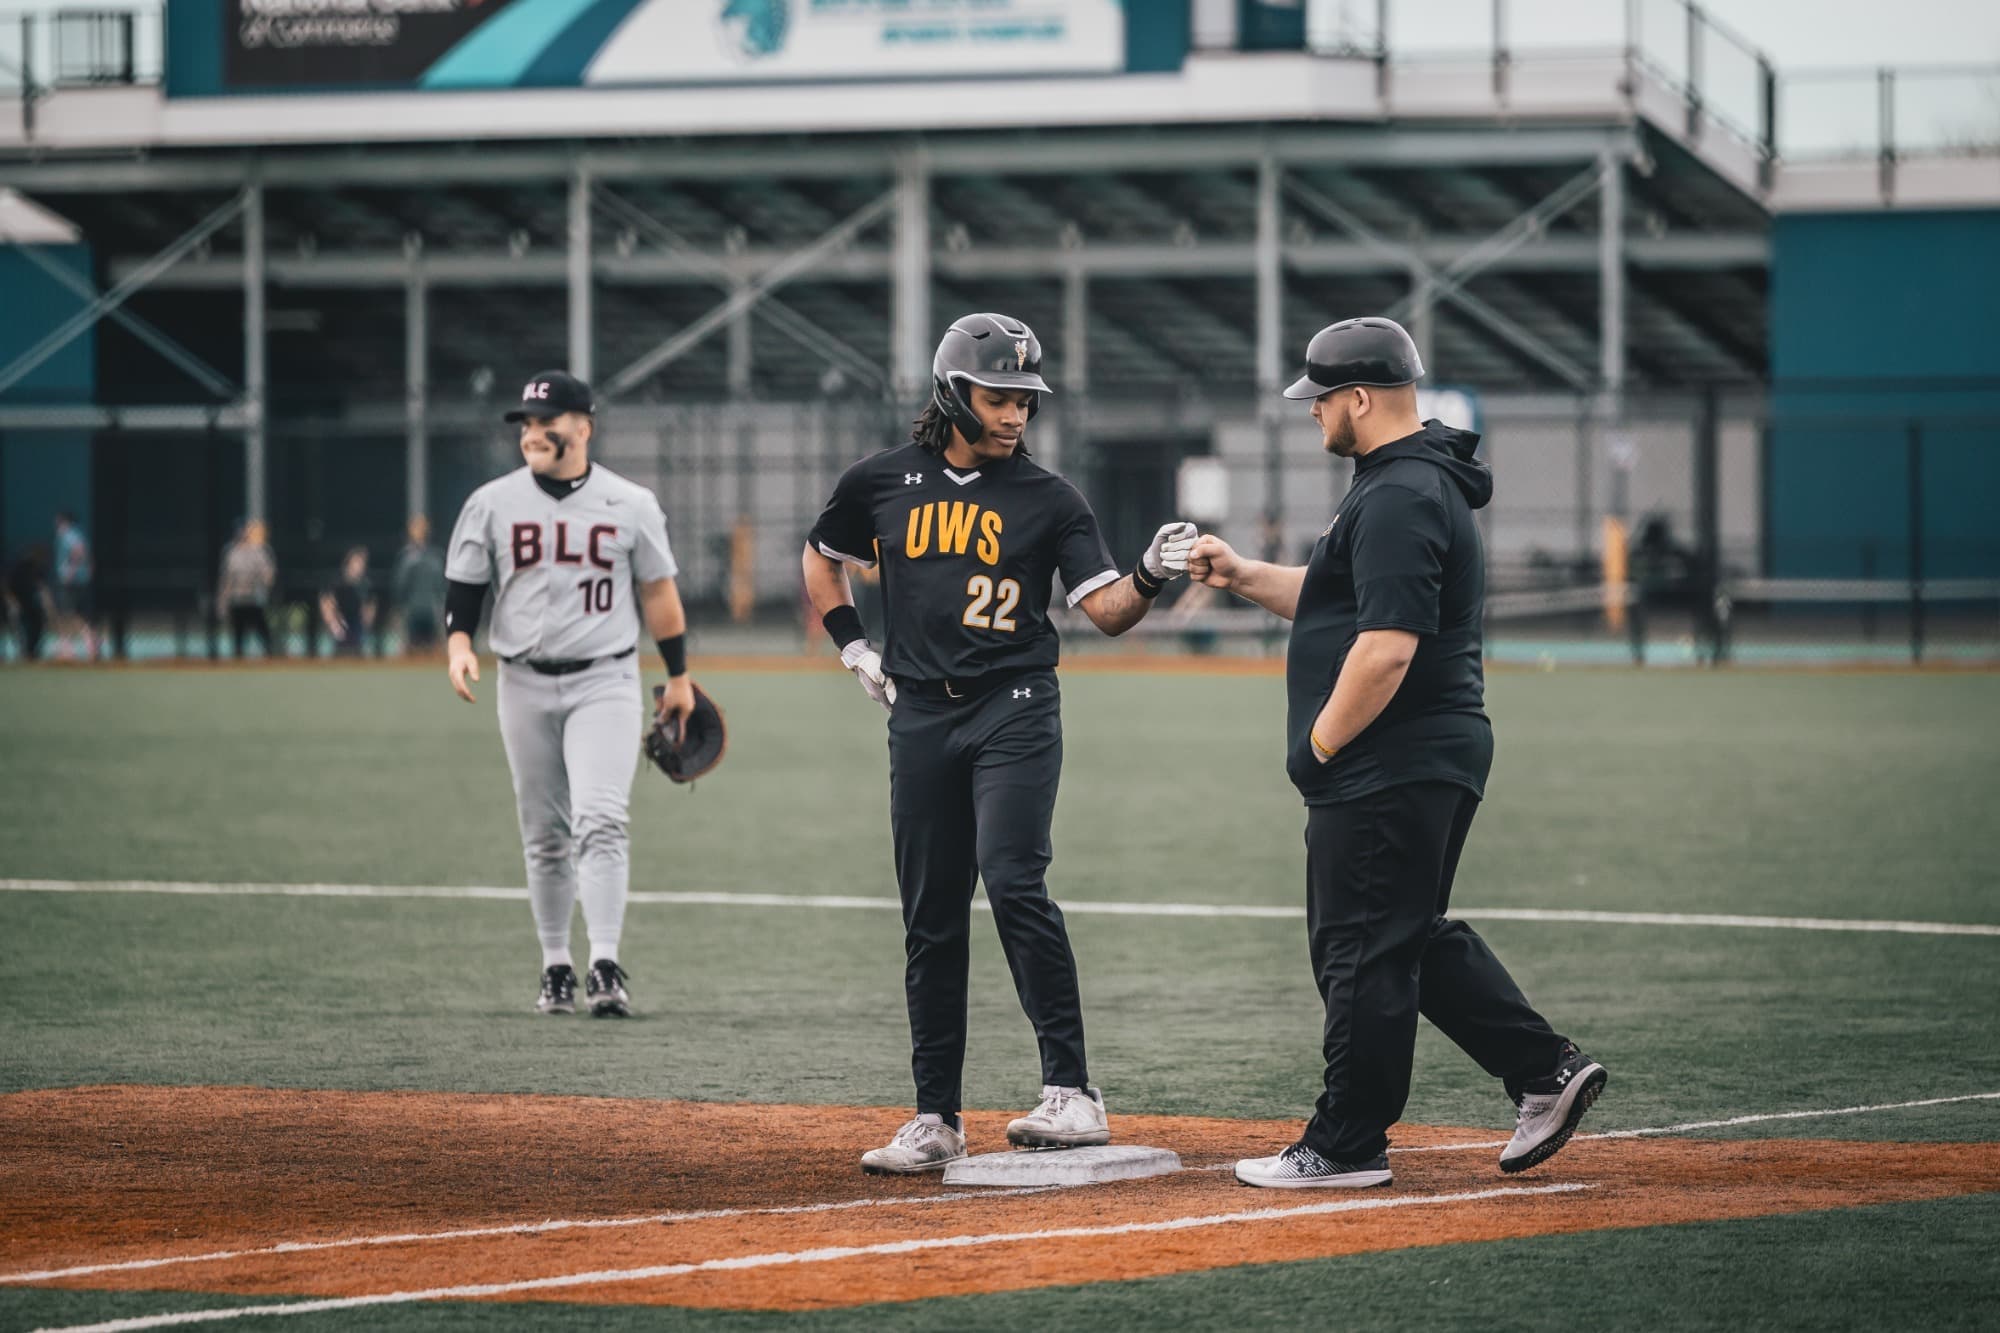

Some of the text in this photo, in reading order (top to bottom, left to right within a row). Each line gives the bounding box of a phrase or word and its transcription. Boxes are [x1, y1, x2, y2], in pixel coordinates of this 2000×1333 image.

[511, 521, 617, 571] BLC
[906, 501, 1003, 566] UWS
[577, 576, 614, 615] 10
[962, 574, 1021, 632] 22
